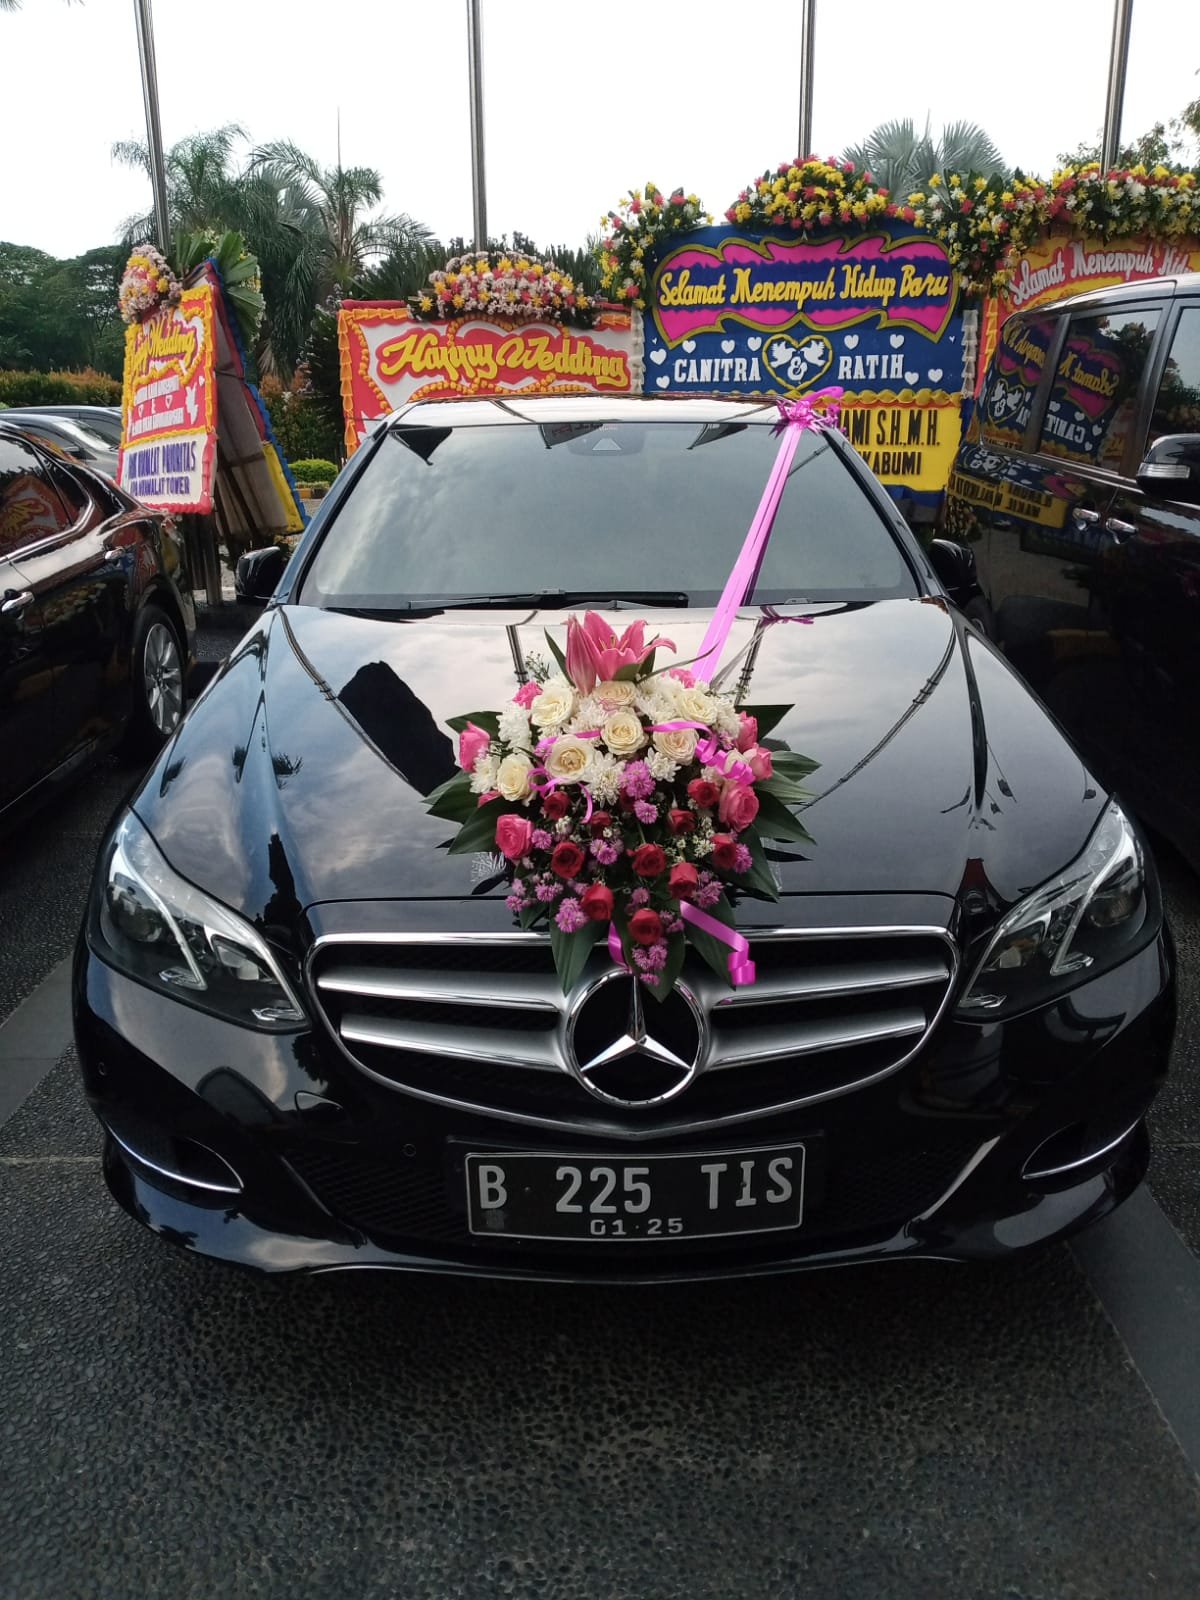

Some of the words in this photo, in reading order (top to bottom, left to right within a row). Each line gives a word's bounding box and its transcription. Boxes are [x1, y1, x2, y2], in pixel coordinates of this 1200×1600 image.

[660, 269, 726, 306] Selamat
[730, 267, 836, 310] Menempuh
[840, 265, 896, 307] Hidup
[900, 265, 949, 298] Baru
[1009, 251, 1066, 305] Selamat
[1069, 241, 1154, 281] Menempuh
[381, 333, 498, 381] Happy
[498, 336, 629, 388] Wedding
[674, 357, 762, 383] CANITRA
[787, 359, 807, 381] &
[837, 354, 905, 381] RATIH
[166, 476, 190, 495] TOWER
[478, 1165, 508, 1209] B
[556, 1166, 651, 1213] 225
[701, 1157, 793, 1210] TIS
